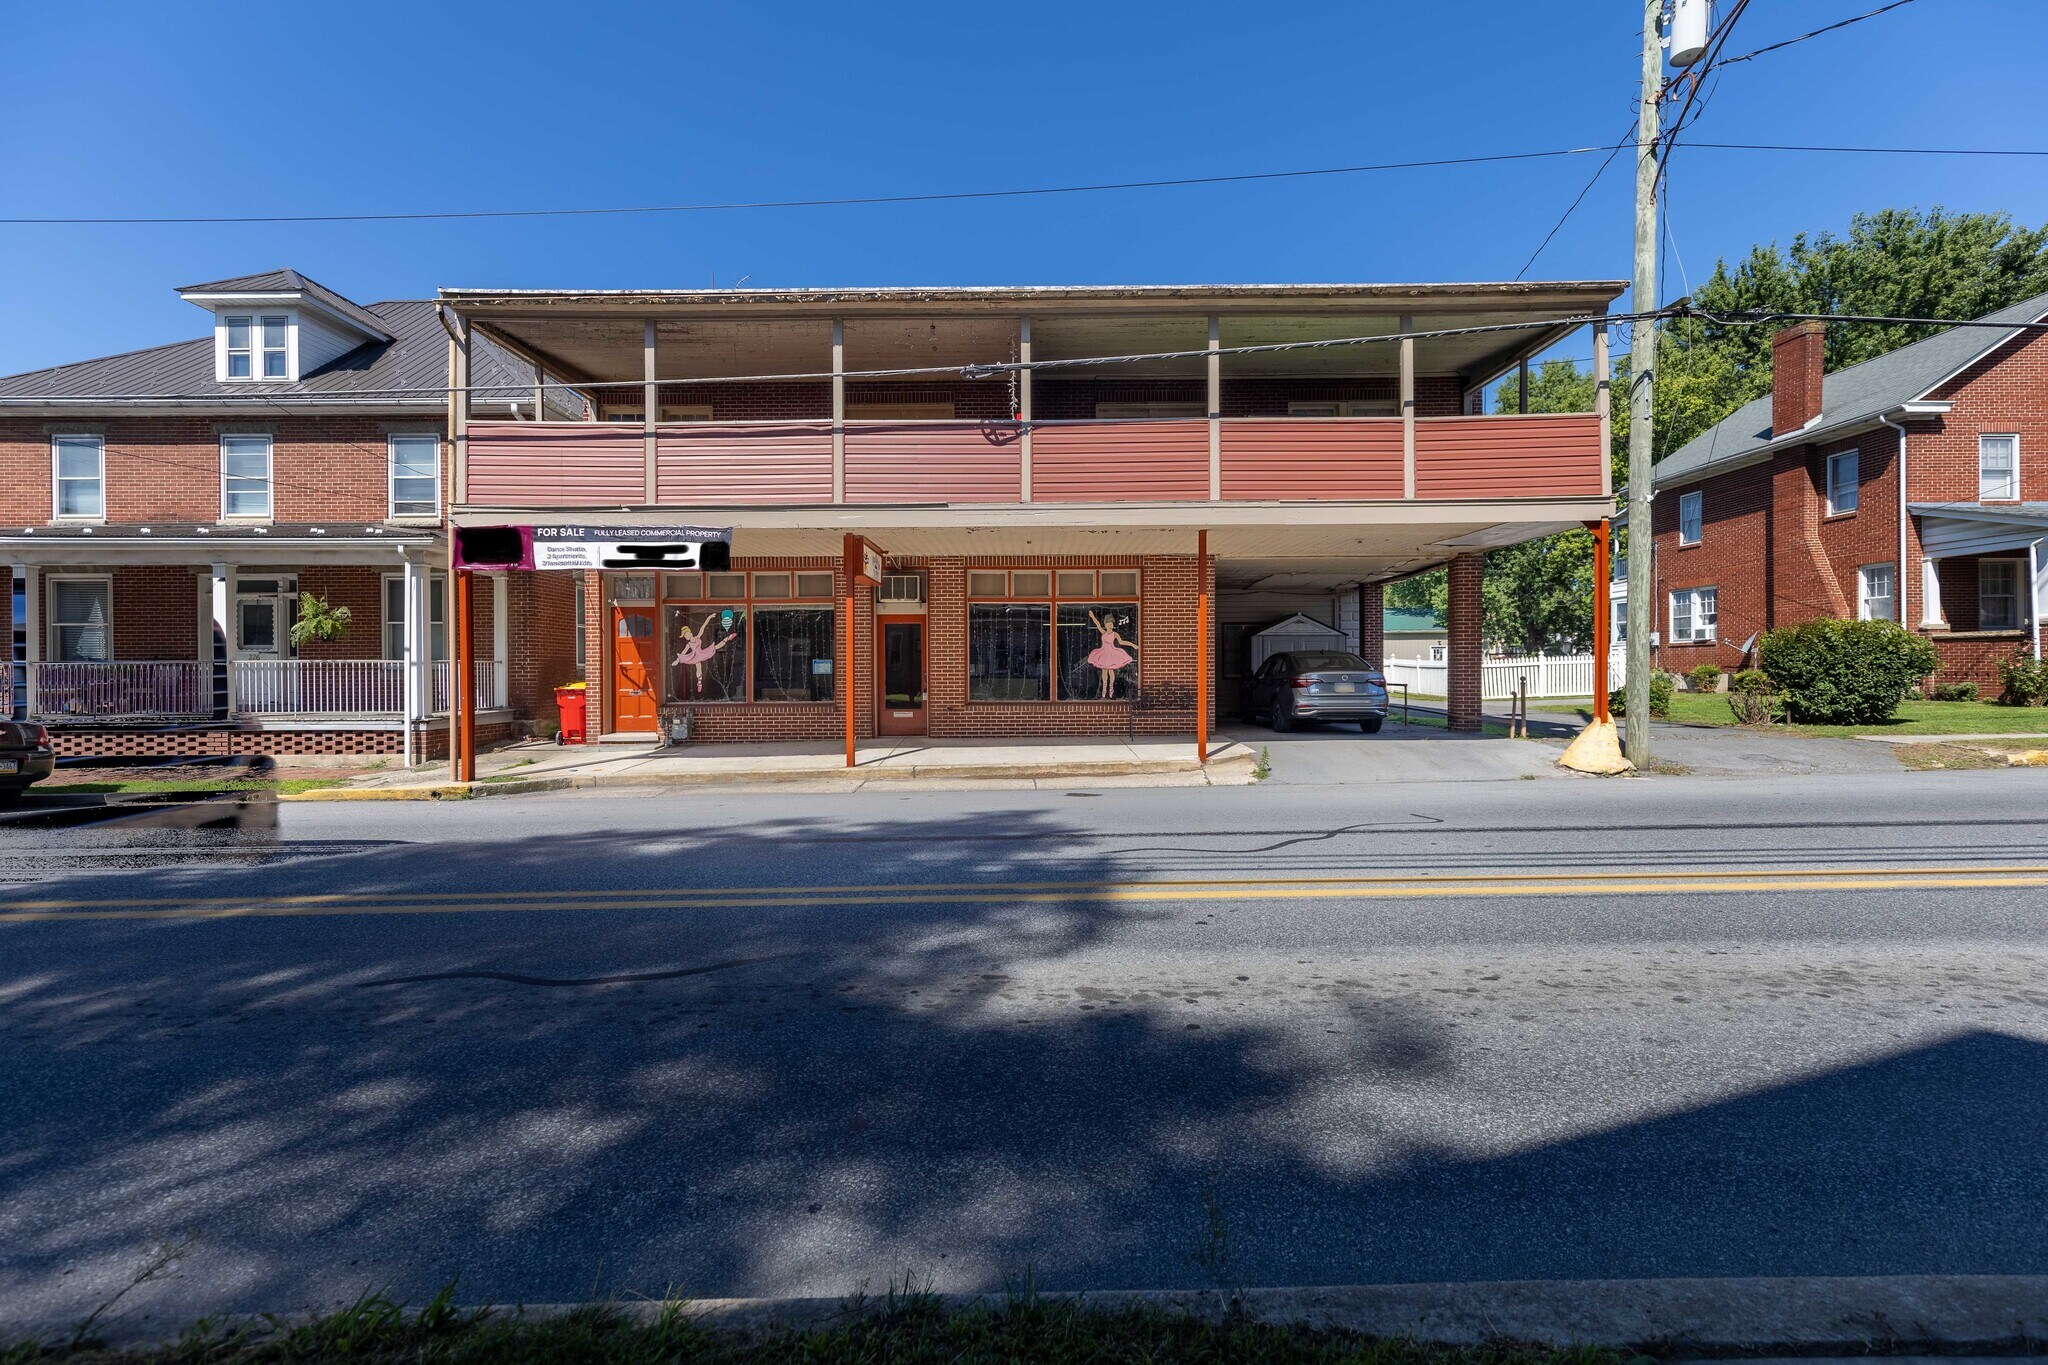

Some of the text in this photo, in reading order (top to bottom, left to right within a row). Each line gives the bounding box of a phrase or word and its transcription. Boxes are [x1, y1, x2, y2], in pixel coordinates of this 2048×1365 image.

[537, 528, 585, 537] FOR SALE
[594, 529, 722, 538] FULLY LEASED COMMERCIAL PROPERTY
